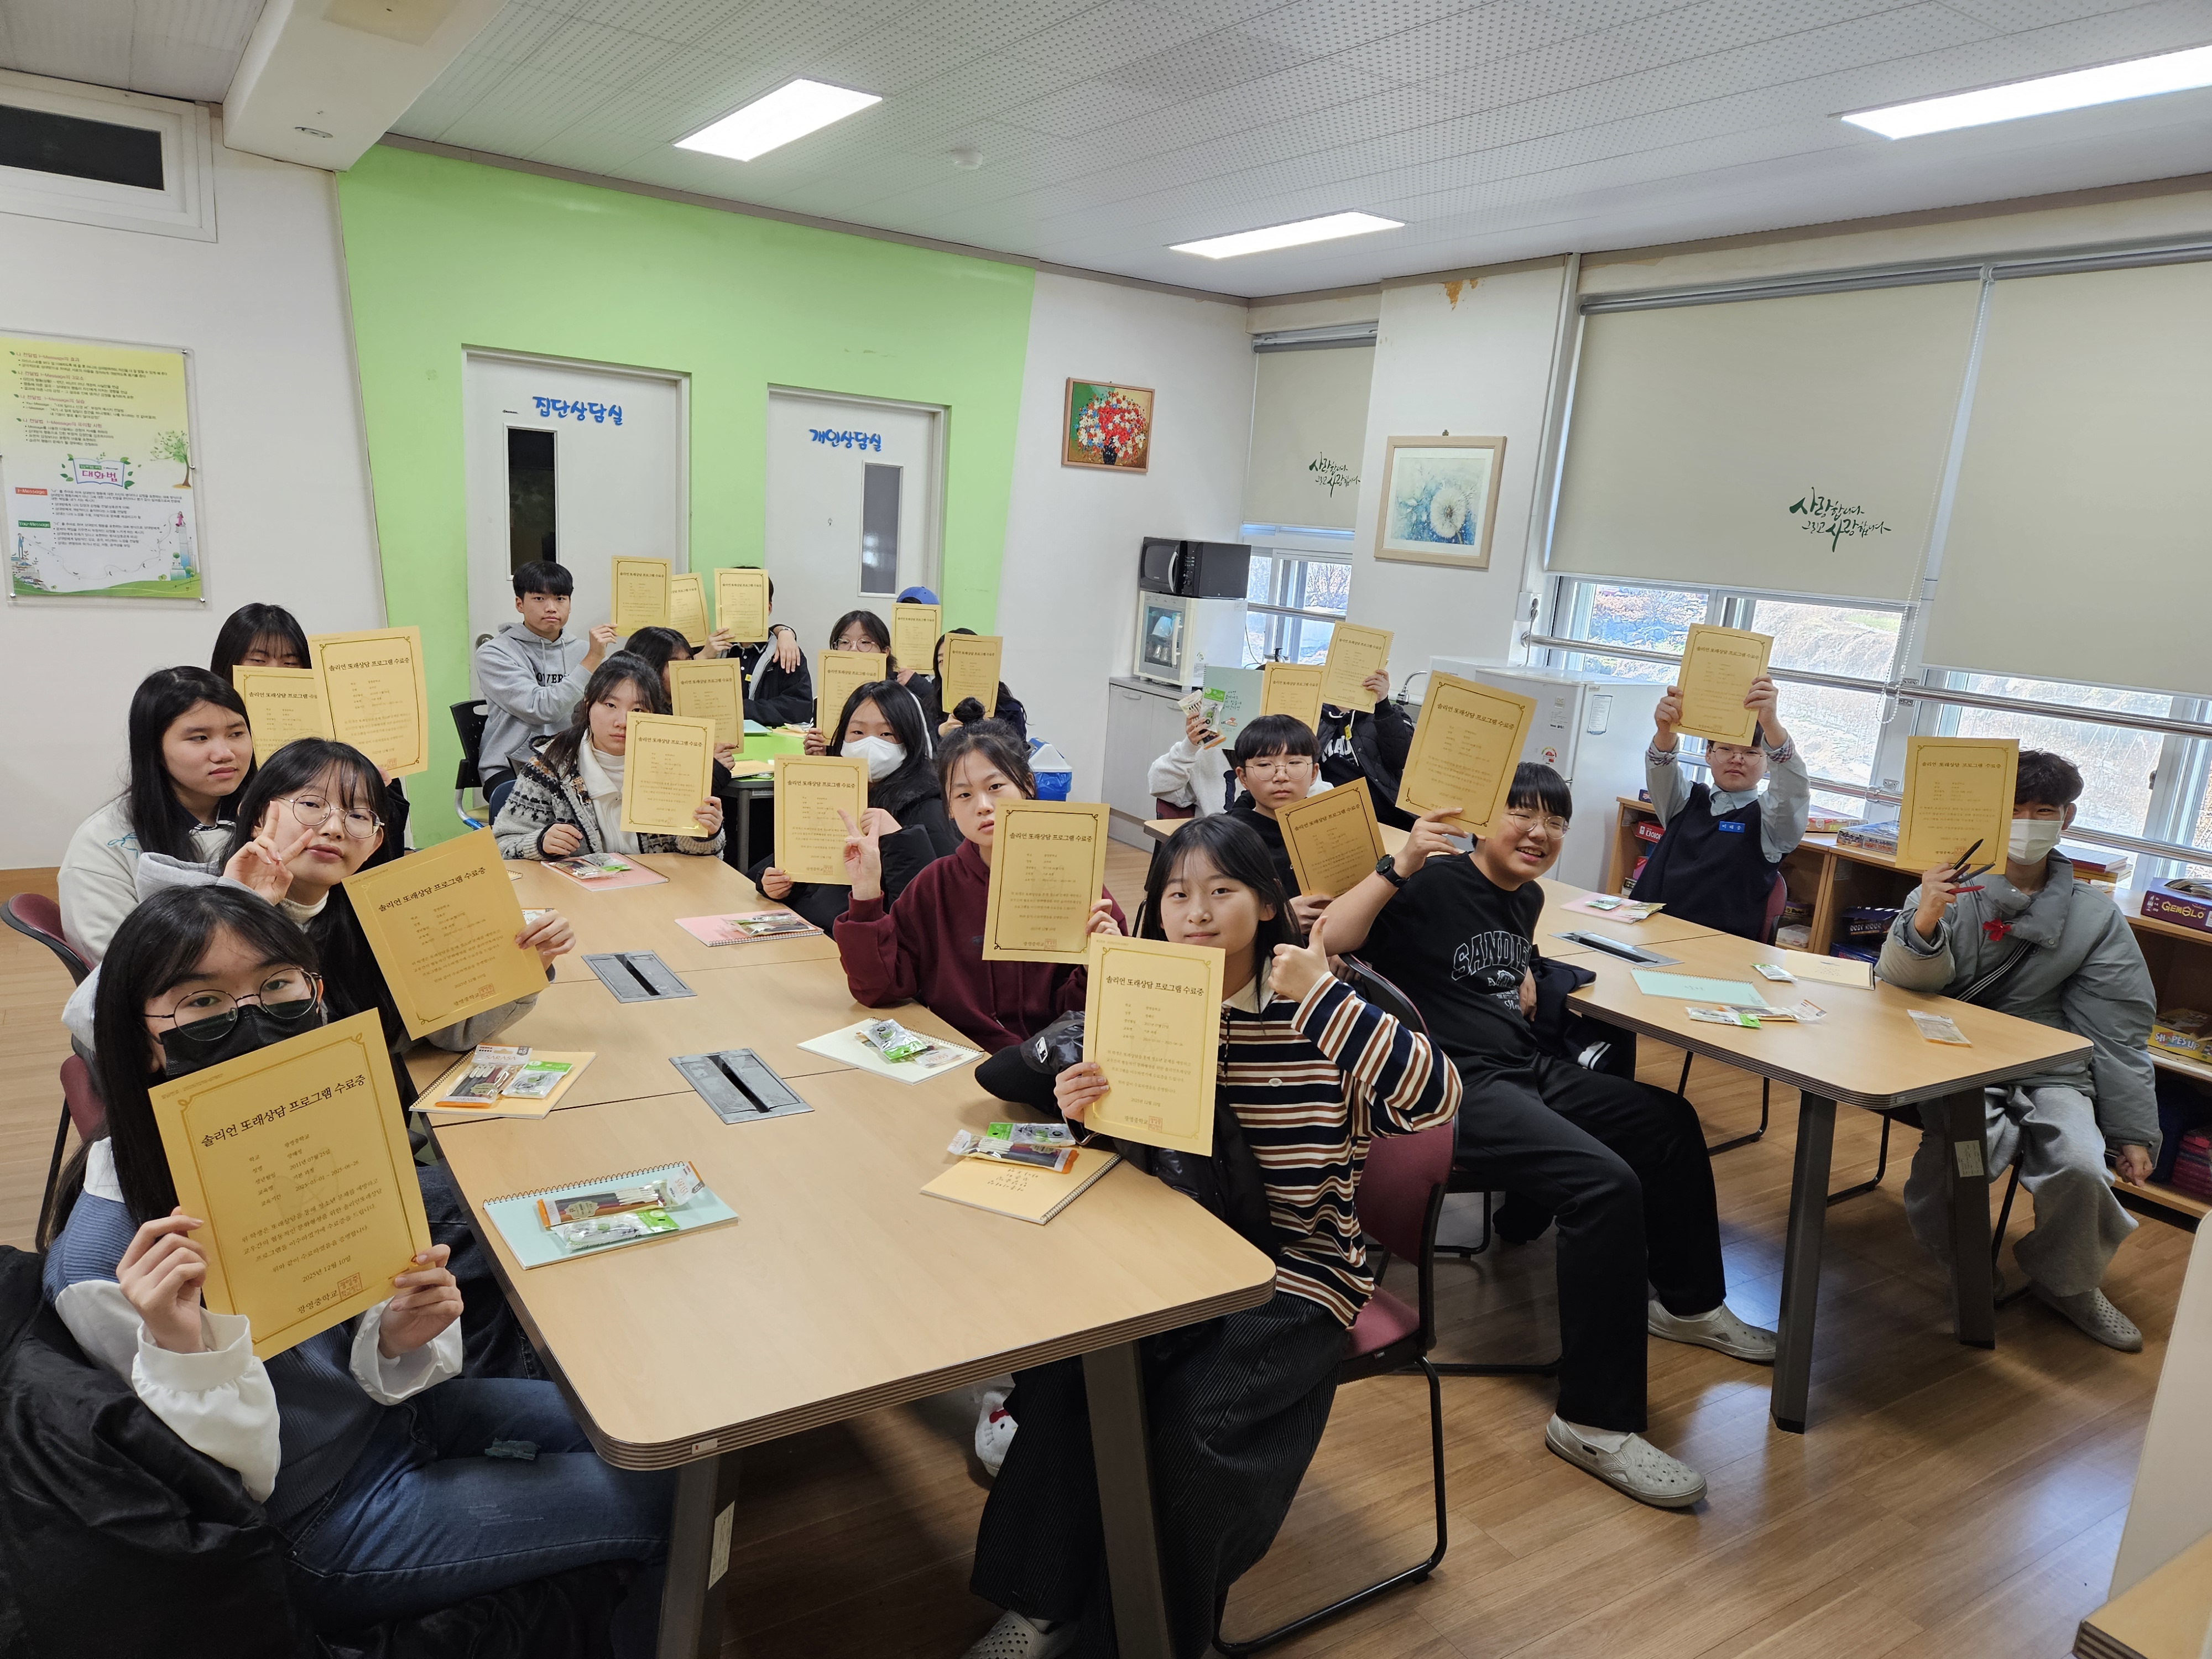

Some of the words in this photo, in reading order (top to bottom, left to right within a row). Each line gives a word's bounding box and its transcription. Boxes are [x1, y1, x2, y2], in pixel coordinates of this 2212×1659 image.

[533, 396, 623, 426] 집단상담실
[810, 429, 883, 452] 개인상담실
[1309, 451, 1348, 476] 사랑합니다
[82, 471, 117, 482] 대화법
[1790, 487, 1865, 521] 사랑합니다
[1437, 703, 1453, 712] 솔리언
[1453, 708, 1475, 718] 또래상담
[1475, 714, 1498, 725] 프로그램
[1498, 721, 1514, 729] 수료증
[378, 898, 402, 911] 솔리언
[403, 886, 432, 902] 또래상담
[432, 875, 463, 891] 프로그램
[464, 867, 486, 879] 수료증
[2161, 901, 2204, 919] GEMBLO
[1451, 930, 1532, 981] SANDIE
[1106, 975, 1125, 985] 솔리언
[1127, 979, 1154, 989] 또래상담
[1155, 983, 1181, 993] 프로그램
[1183, 986, 1204, 996] 수료증
[2188, 1041, 2200, 1050] UP
[201, 1124, 238, 1147] 솔리언
[240, 1105, 286, 1131] 또래상담
[289, 1087, 332, 1112] 프로그램
[335, 1074, 366, 1094] 수료증
